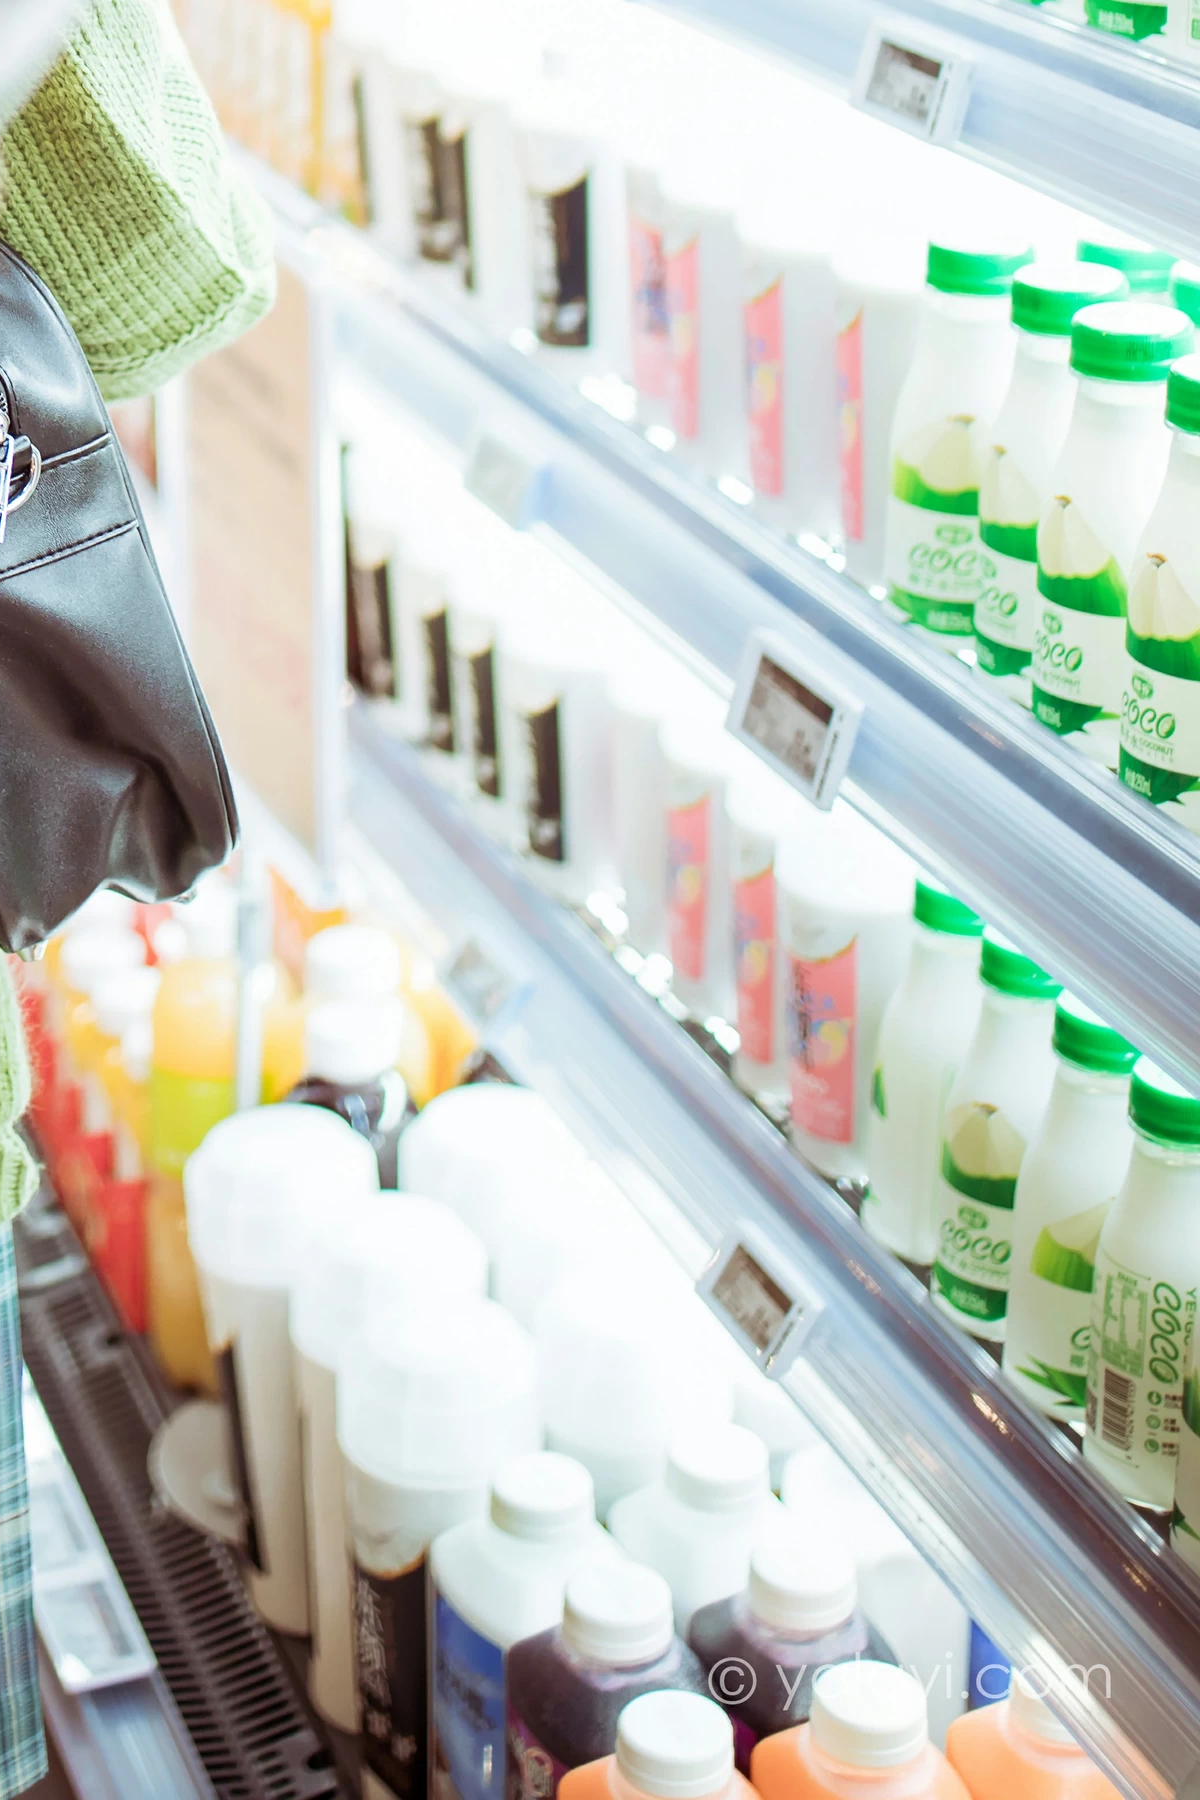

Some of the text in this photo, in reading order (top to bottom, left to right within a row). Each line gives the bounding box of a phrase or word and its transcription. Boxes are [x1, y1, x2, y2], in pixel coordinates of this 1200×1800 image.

[908, 543, 978, 577] COC
[1121, 691, 1176, 740] COCO
[940, 1218, 1012, 1265] COCO
[1149, 1281, 1182, 1385] COCO
